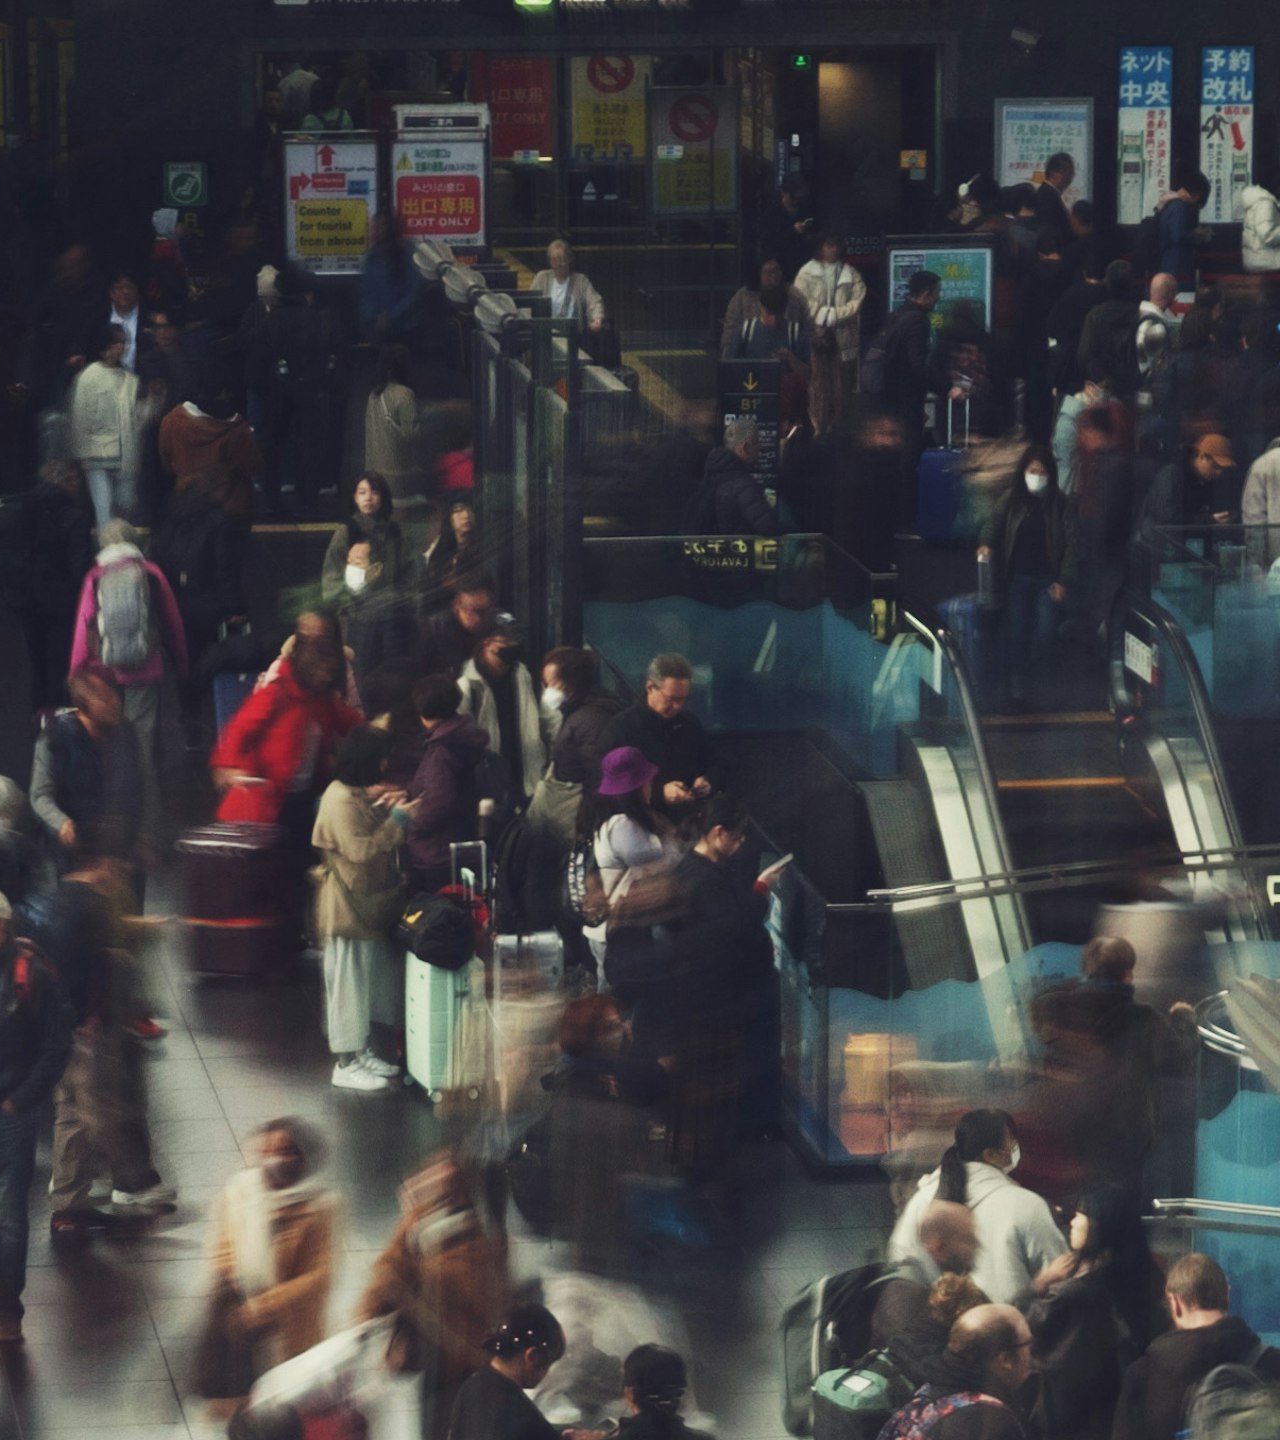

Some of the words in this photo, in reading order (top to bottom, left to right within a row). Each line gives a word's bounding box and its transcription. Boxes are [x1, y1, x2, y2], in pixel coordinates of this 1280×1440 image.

[1121, 50, 1170, 73] ネット
[1205, 49, 1251, 73] 予約
[492, 88, 544, 103] 口専用
[1120, 80, 1169, 105] 中央
[1203, 76, 1253, 101] 改札
[412, 182, 466, 193] みどりの窓口
[299, 206, 341, 217] Counter
[403, 197, 476, 215] 出口専用
[299, 222, 314, 231] for
[317, 221, 352, 231] tourist
[408, 218, 434, 227] EXIT
[439, 217, 471, 227] ONLY
[299, 236, 325, 246] from
[327, 235, 365, 246] abroad
